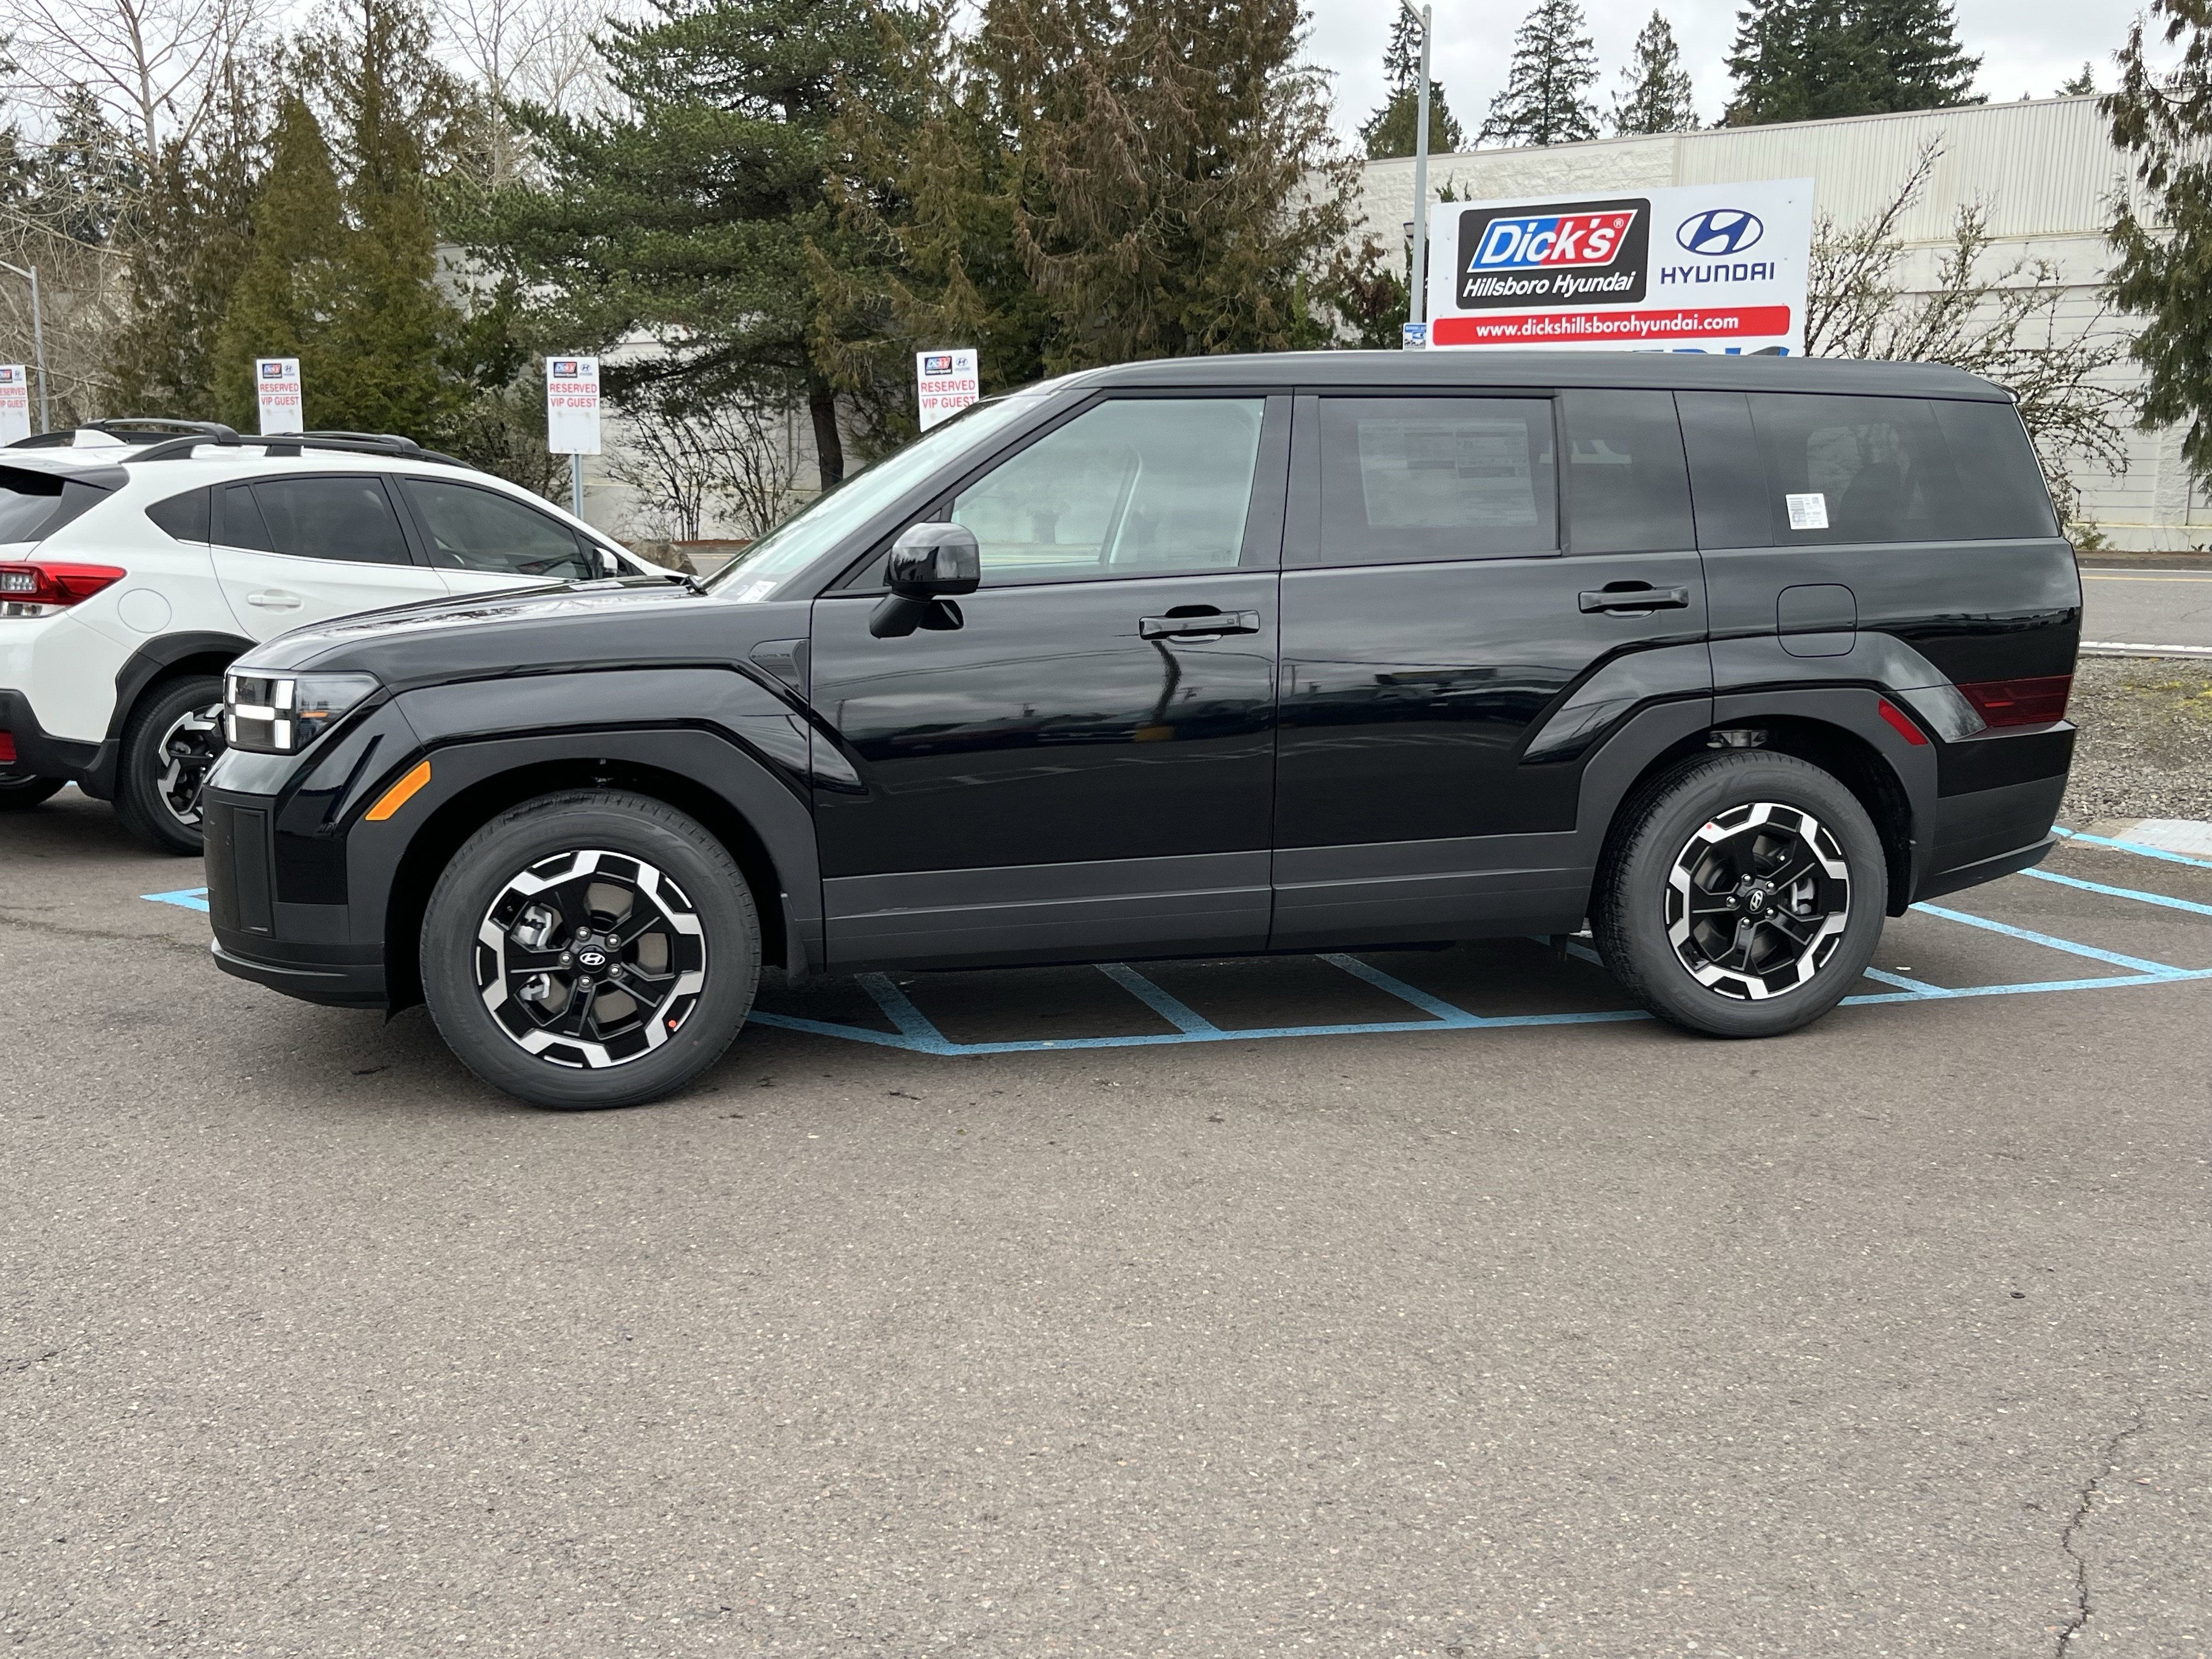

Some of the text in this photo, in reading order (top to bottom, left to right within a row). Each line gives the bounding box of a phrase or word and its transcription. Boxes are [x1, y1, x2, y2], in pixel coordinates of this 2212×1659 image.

[1480, 218, 1616, 264] Dick's
[1661, 262, 1775, 284] HYUNDAI
[1463, 271, 1637, 298] Hillsboro Hyundai
[1476, 313, 1739, 337] www.dickshillsborohyundai.com
[259, 383, 298, 392] RESERVED
[550, 383, 597, 393] RESERVED
[921, 380, 975, 392] RESERVED
[261, 396, 299, 405] VIP GUEST
[551, 398, 597, 407] VIP GUEST
[922, 396, 975, 409] VIP GUEST
